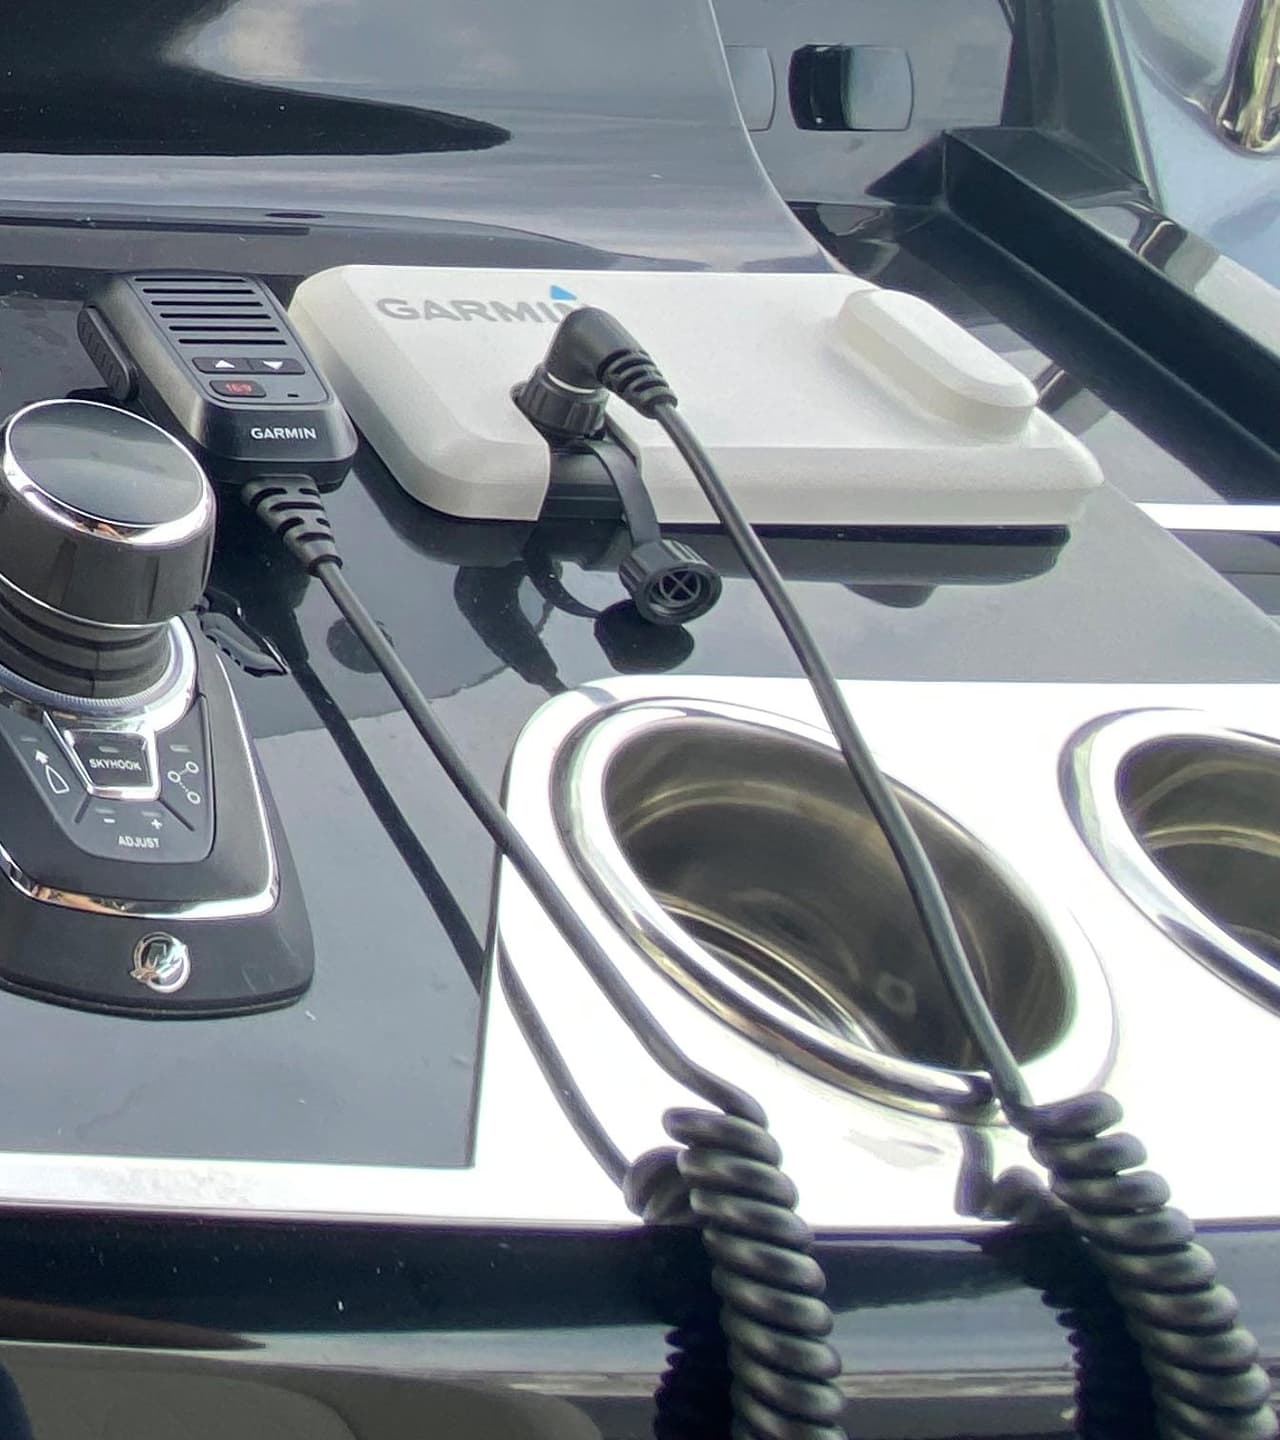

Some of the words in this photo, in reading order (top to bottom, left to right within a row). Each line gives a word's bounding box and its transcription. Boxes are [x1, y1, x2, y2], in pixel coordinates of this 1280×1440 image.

[250, 427, 317, 440] GARMIN
[89, 758, 142, 771] SKYHOOK
[118, 835, 160, 849] ADJUST
